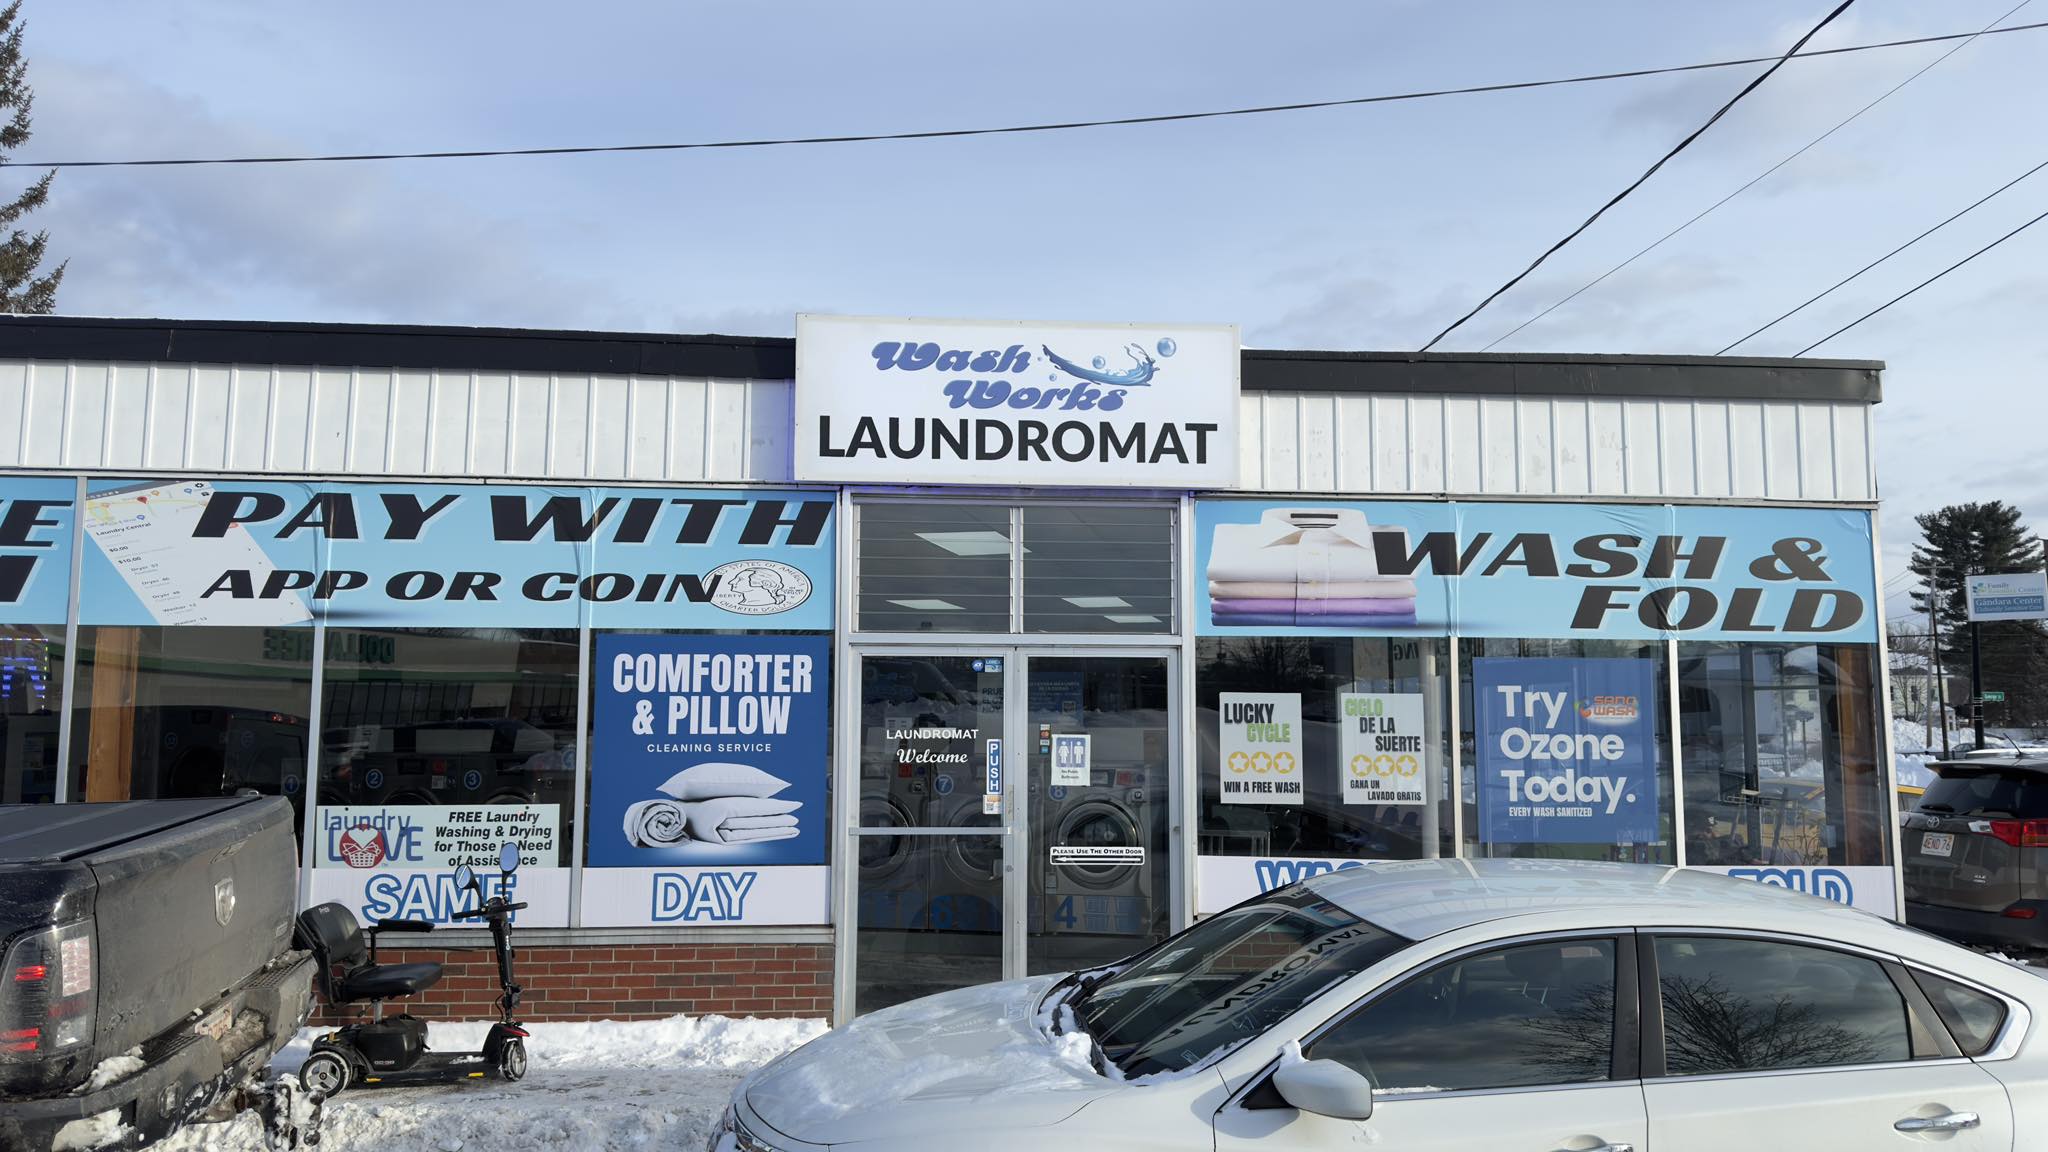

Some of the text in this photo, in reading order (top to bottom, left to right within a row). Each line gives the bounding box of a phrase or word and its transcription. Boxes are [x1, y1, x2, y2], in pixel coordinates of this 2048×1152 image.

[871, 341, 1031, 373] Wash
[943, 380, 1128, 411] Works
[819, 415, 1218, 464] LAUNDROMAT
[0, 500, 73, 547] E
[191, 491, 834, 545] PAY WITH
[1372, 531, 1833, 582] WASH &
[200, 569, 723, 603] APP OR COIN
[1570, 585, 1864, 632] FOLD
[613, 653, 813, 693] COMFORTER
[632, 695, 791, 735] & PILLOW
[1224, 703, 1275, 725] LUCKY
[1497, 685, 1568, 729] Try
[886, 729, 979, 740] LAUNDROMAT
[1247, 723, 1291, 743] CYCLE
[1360, 717, 1396, 734] DE LA
[647, 743, 772, 753] CLEANING SERVICE
[896, 748, 969, 764] Welcome
[1375, 735, 1421, 752] SUERTE
[1500, 727, 1625, 760] Ozone
[990, 743, 999, 791] PUSH
[1224, 781, 1301, 794] WIN A FREE WASH
[1350, 780, 1380, 789] GANA UN
[1368, 791, 1422, 801] LAVADO GRATIS
[1501, 768, 1636, 815] Today.
[324, 808, 411, 836] laundry
[449, 811, 540, 825] FREE Laundry
[1509, 807, 1593, 817] EVERY WASH SANITIZED
[434, 840, 452, 852] for
[457, 840, 496, 852] Those
[517, 839, 553, 851] Need
[435, 826, 552, 839] Washing & Drying
[448, 854, 538, 866] of Assisce
[362, 871, 758, 924] SAME DAY
[1056, 895, 1077, 929] 4
